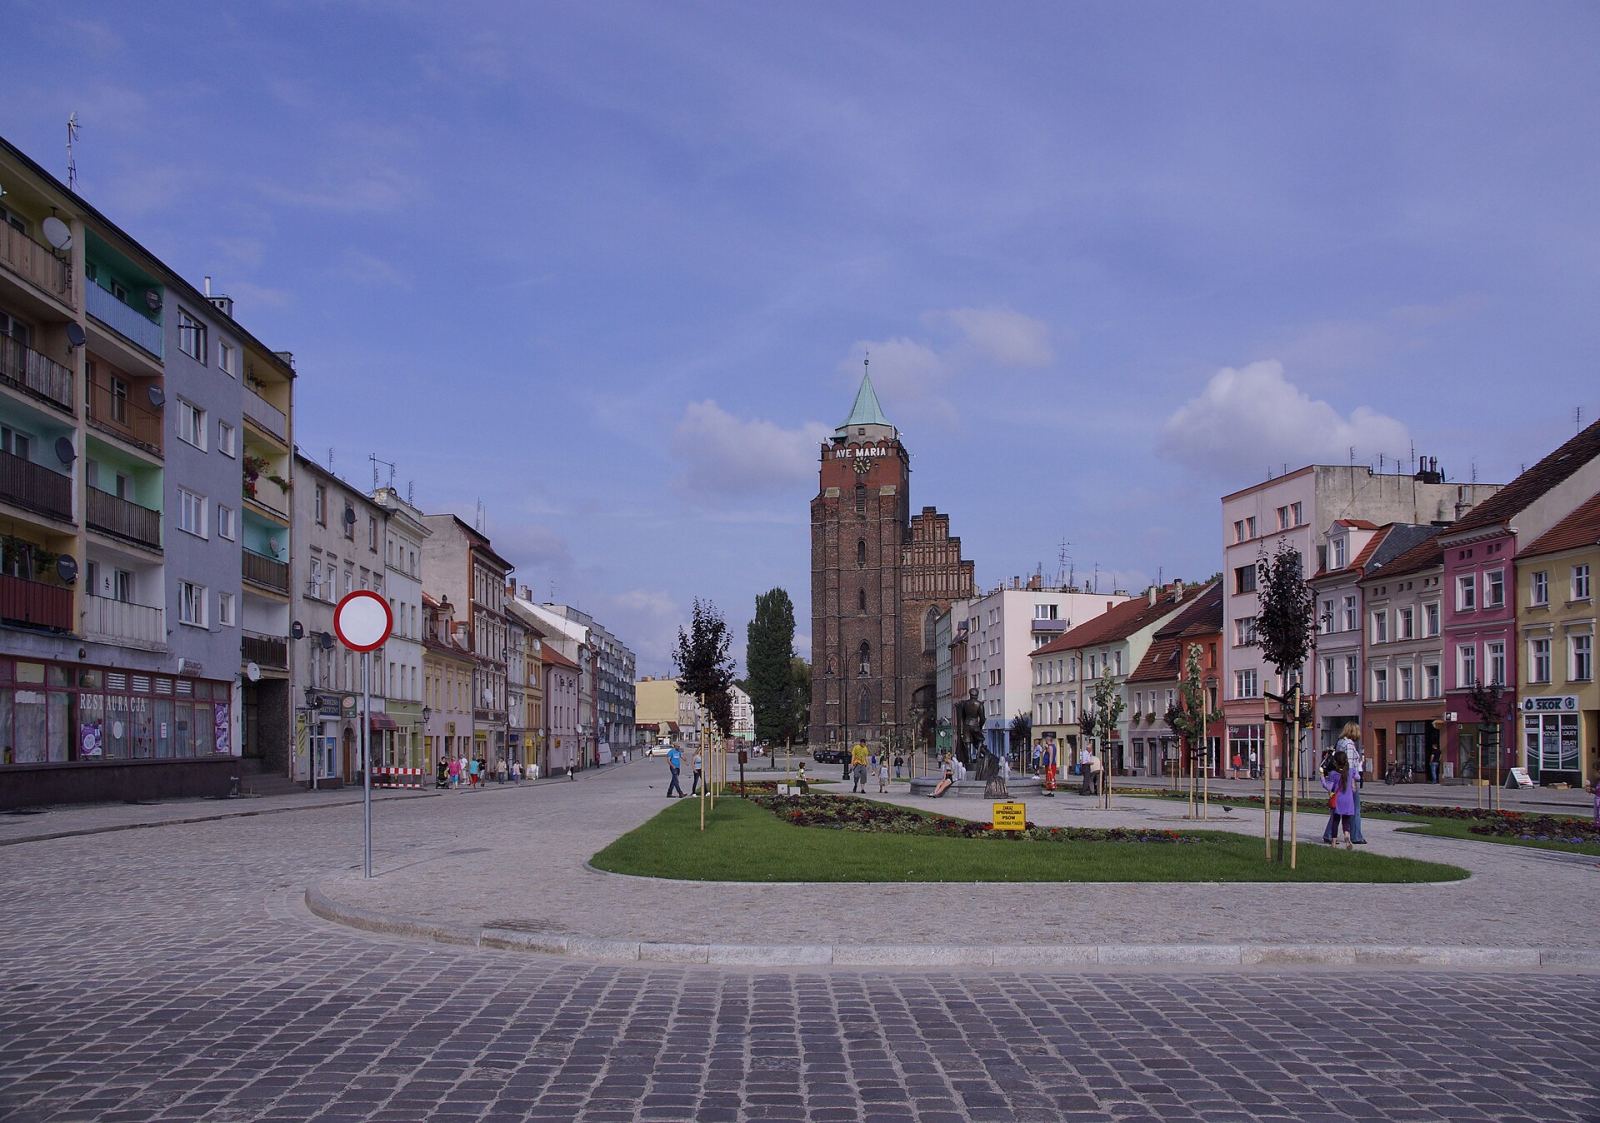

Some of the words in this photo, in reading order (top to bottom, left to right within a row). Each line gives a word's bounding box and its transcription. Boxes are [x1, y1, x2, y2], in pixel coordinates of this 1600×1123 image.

[835, 449, 852, 458] AVE
[855, 447, 886, 457] MARIA
[80, 693, 146, 713] RESTAURACJA
[1536, 700, 1562, 710] SKOK
